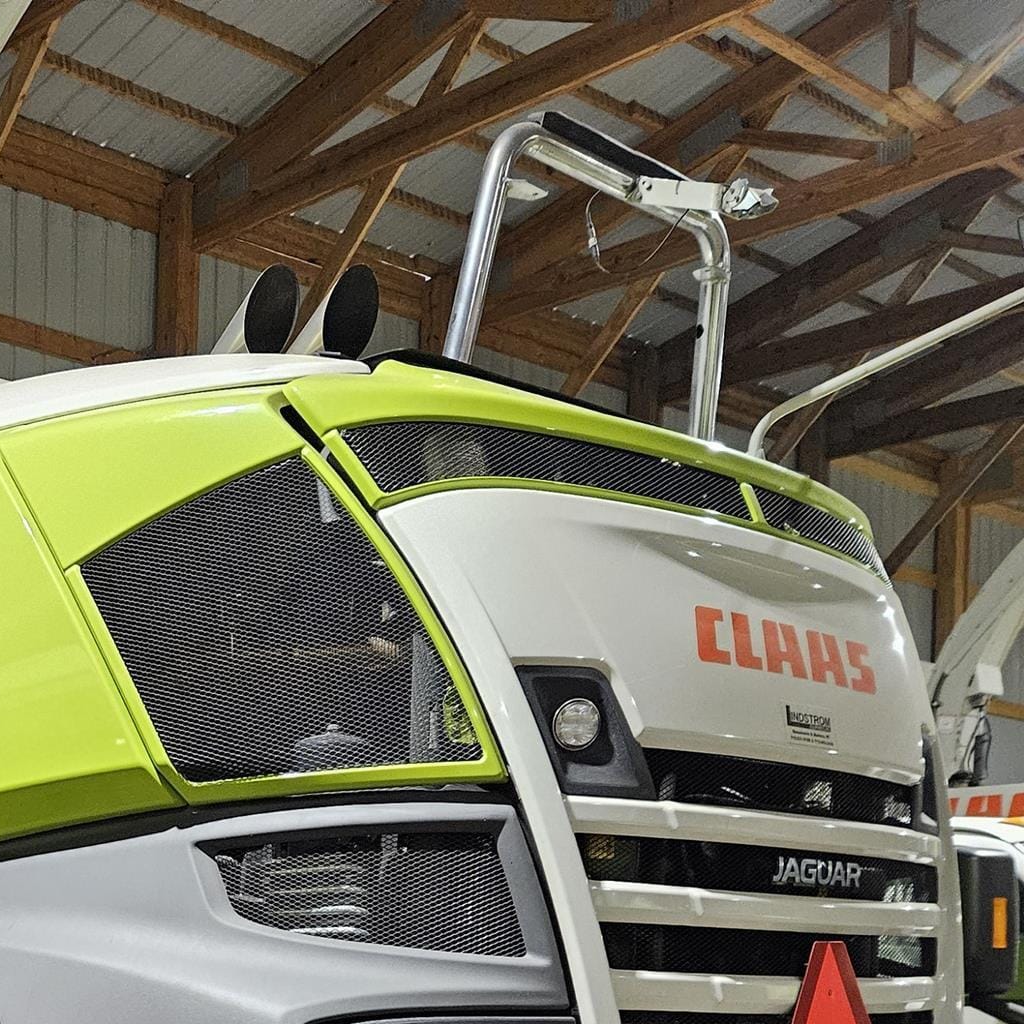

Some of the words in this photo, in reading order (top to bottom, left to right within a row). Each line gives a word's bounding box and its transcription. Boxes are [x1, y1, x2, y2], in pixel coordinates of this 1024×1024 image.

[694, 605, 877, 695] CLAAS
[786, 705, 831, 727] LINDSTROM
[772, 856, 862, 888] JAGUAR
